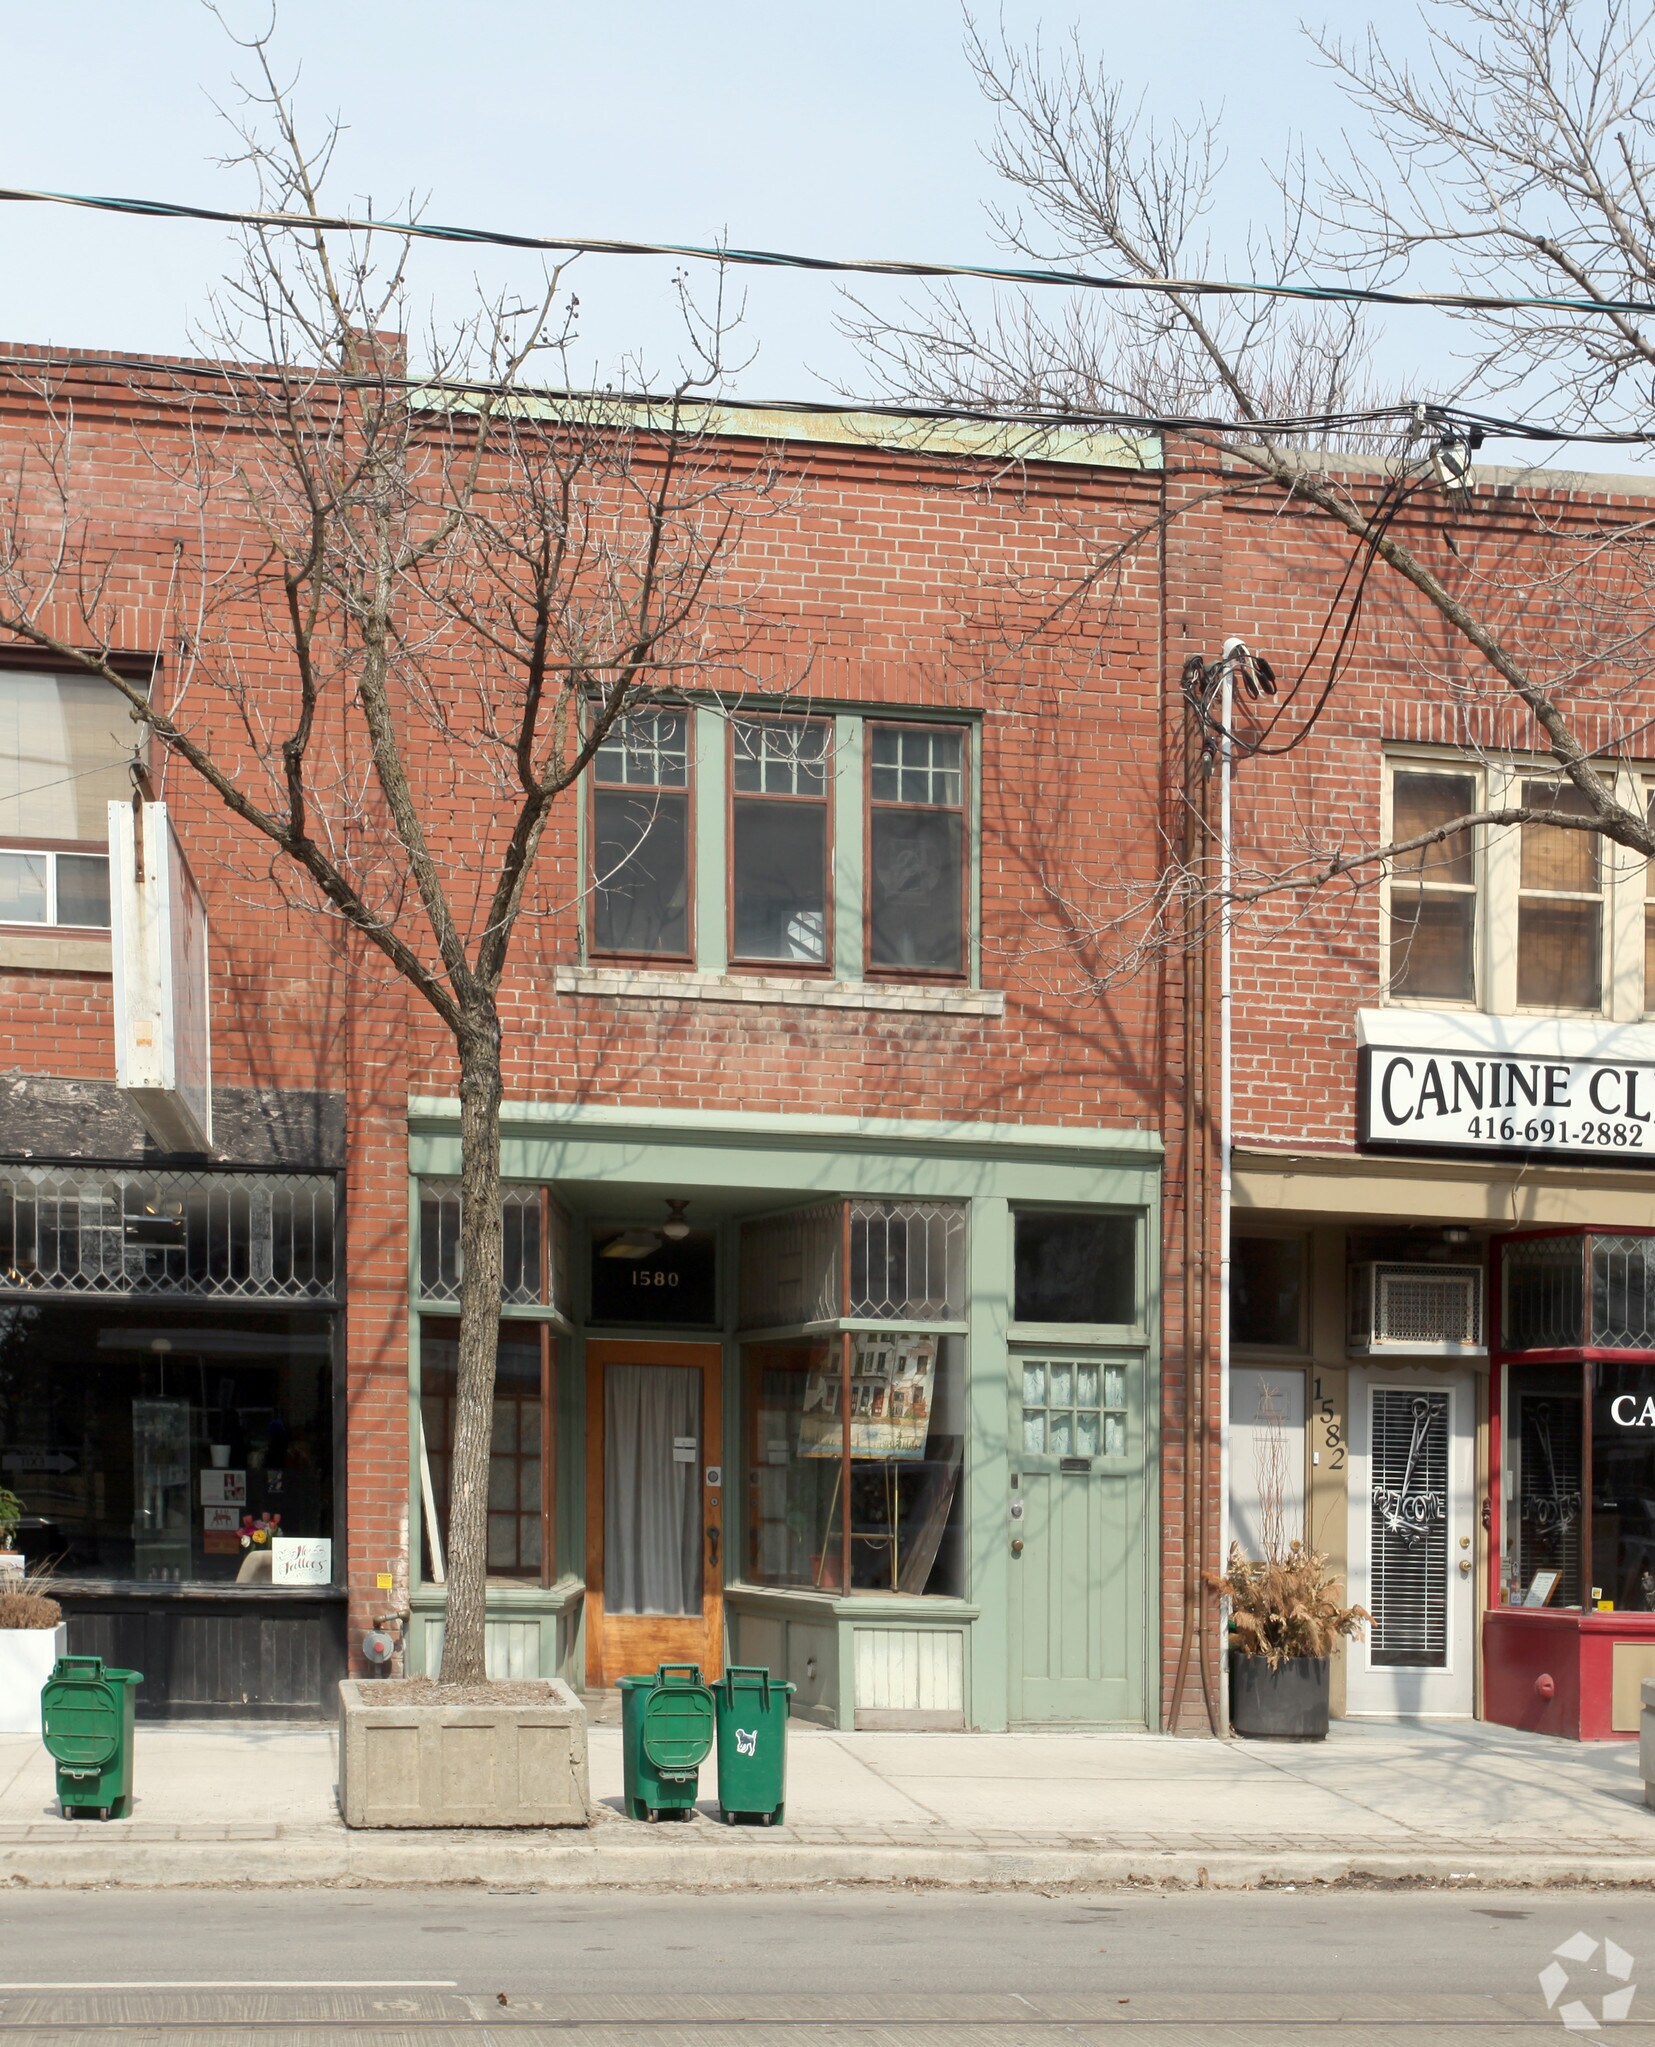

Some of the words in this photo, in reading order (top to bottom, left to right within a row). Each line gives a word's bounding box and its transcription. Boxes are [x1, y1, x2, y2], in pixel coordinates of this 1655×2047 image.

[1381, 1056, 1572, 1126] CANINE
[1589, 1068, 1655, 1123] CL
[1467, 1115, 1643, 1147] 416-691-2882
[632, 1270, 679, 1287] 1580
[1313, 1376, 1345, 1470] 1582
